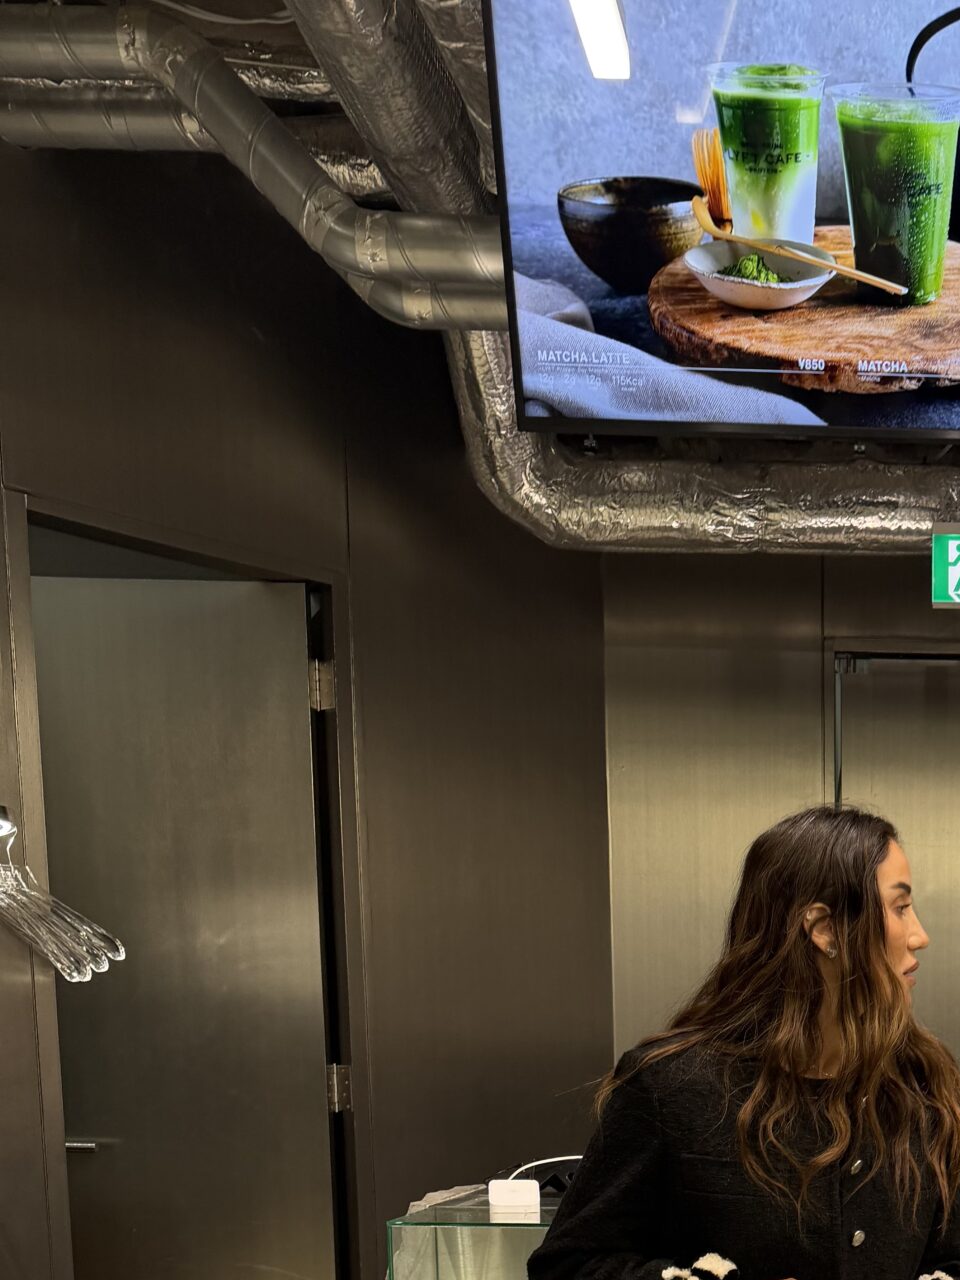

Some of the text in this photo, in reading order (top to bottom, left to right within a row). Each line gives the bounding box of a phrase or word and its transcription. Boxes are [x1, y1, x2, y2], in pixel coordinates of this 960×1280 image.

[537, 350, 825, 371] MATCHA LATTE ¥850
[858, 359, 909, 373] MATCHA
